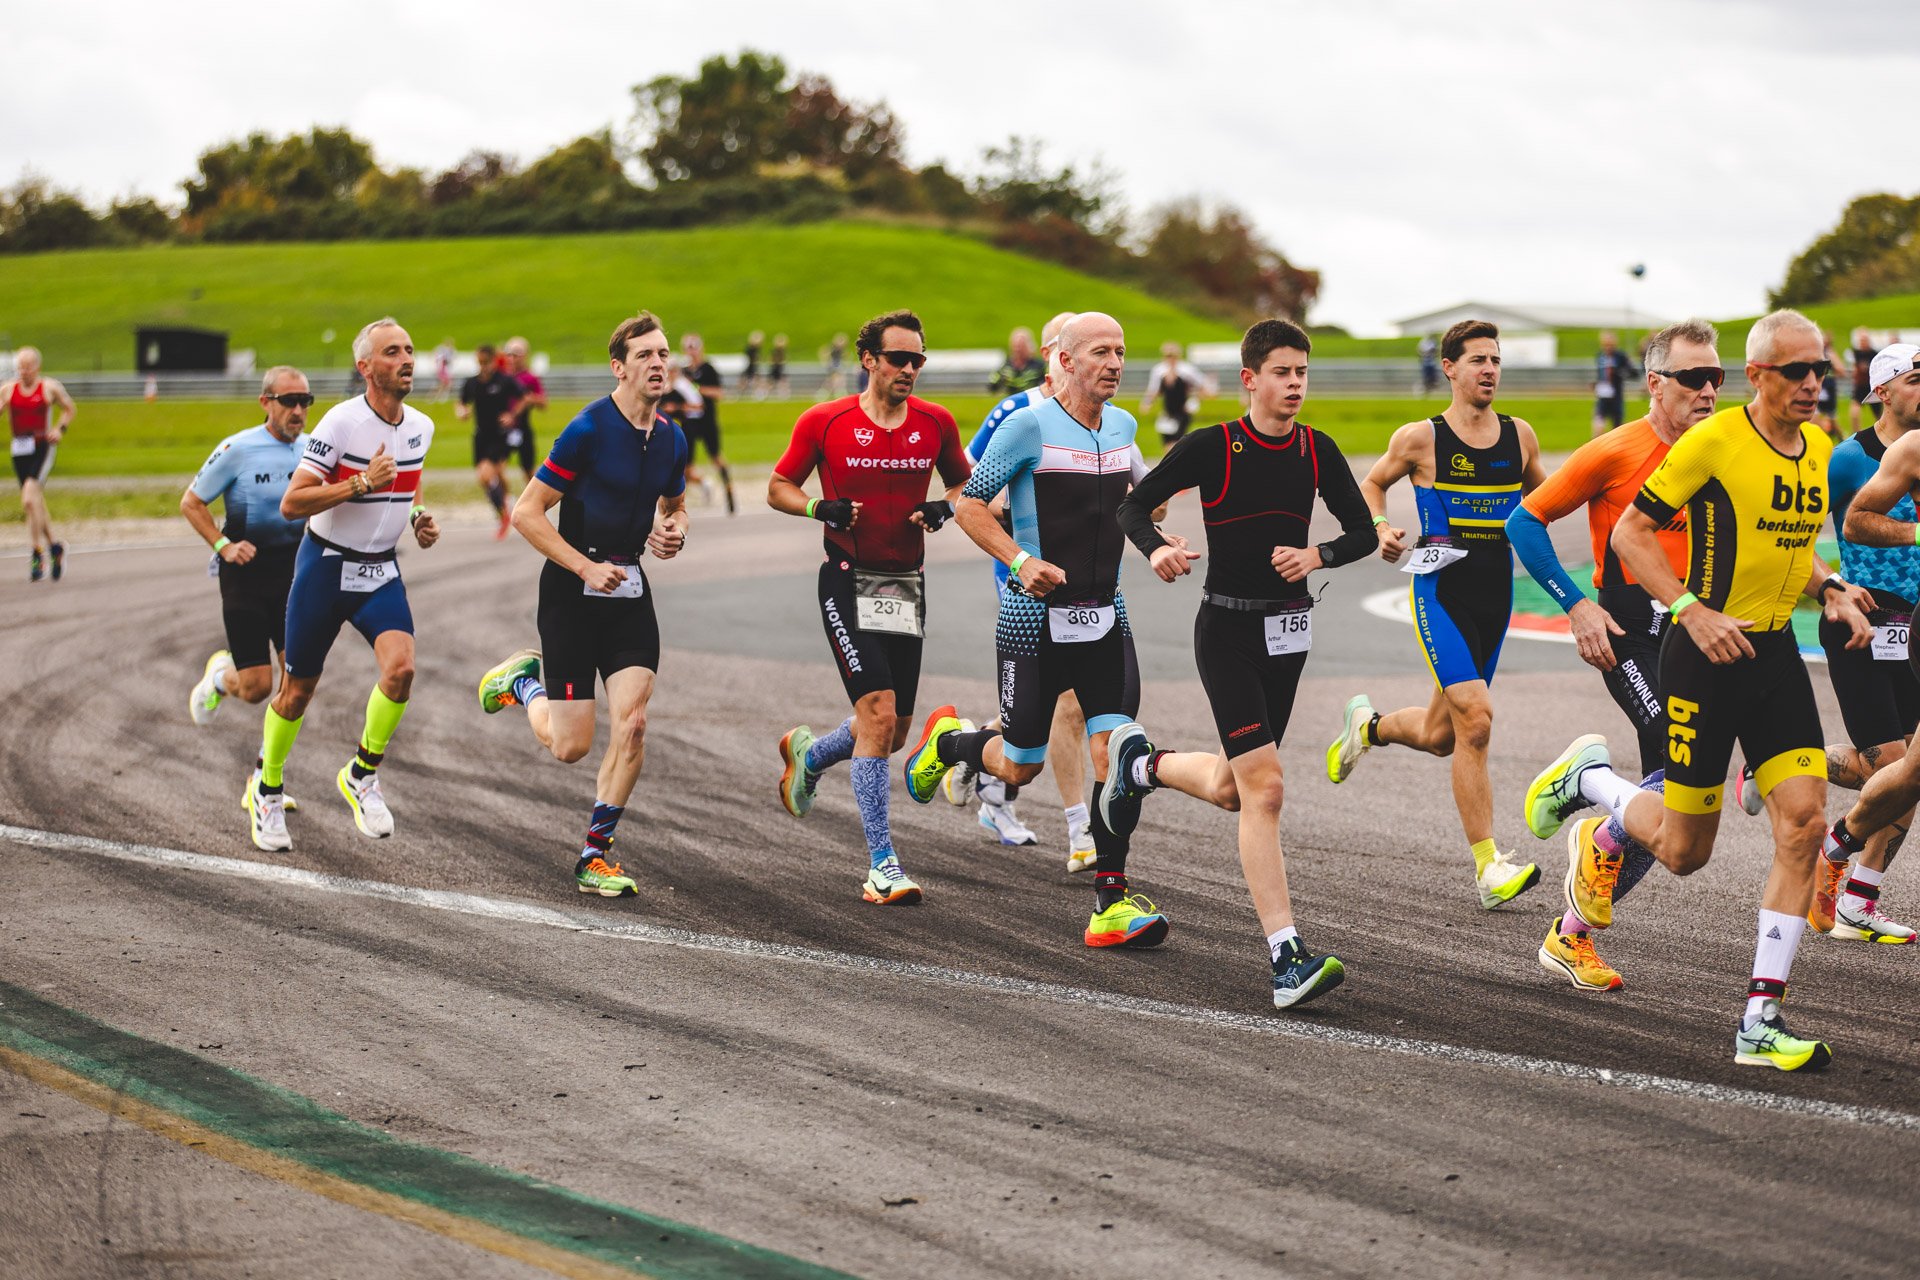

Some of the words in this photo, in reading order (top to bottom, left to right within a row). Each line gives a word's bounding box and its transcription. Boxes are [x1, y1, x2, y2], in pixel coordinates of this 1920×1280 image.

[846, 457, 932, 468] worcester
[1451, 497, 1510, 506] CARDIFF
[1771, 474, 1823, 514] bts
[1756, 517, 1816, 534] berkshire
[1704, 533, 1715, 548] tri
[1776, 535, 1811, 551] squad
[1423, 549, 1445, 563] 23
[358, 564, 385, 578] 278
[1698, 549, 1714, 599] berkshire
[874, 600, 902, 615] 237
[1068, 610, 1099, 625] 360
[1280, 614, 1308, 633] 156
[825, 597, 862, 672] worcester
[1418, 597, 1433, 643] CARDIFF
[1430, 646, 1438, 665] TRI
[1007, 660, 1016, 708] HARROGATE
[1621, 659, 1661, 718] BROWNLEE
[1615, 668, 1650, 725] FITNESS
[1667, 695, 1699, 767] bts
